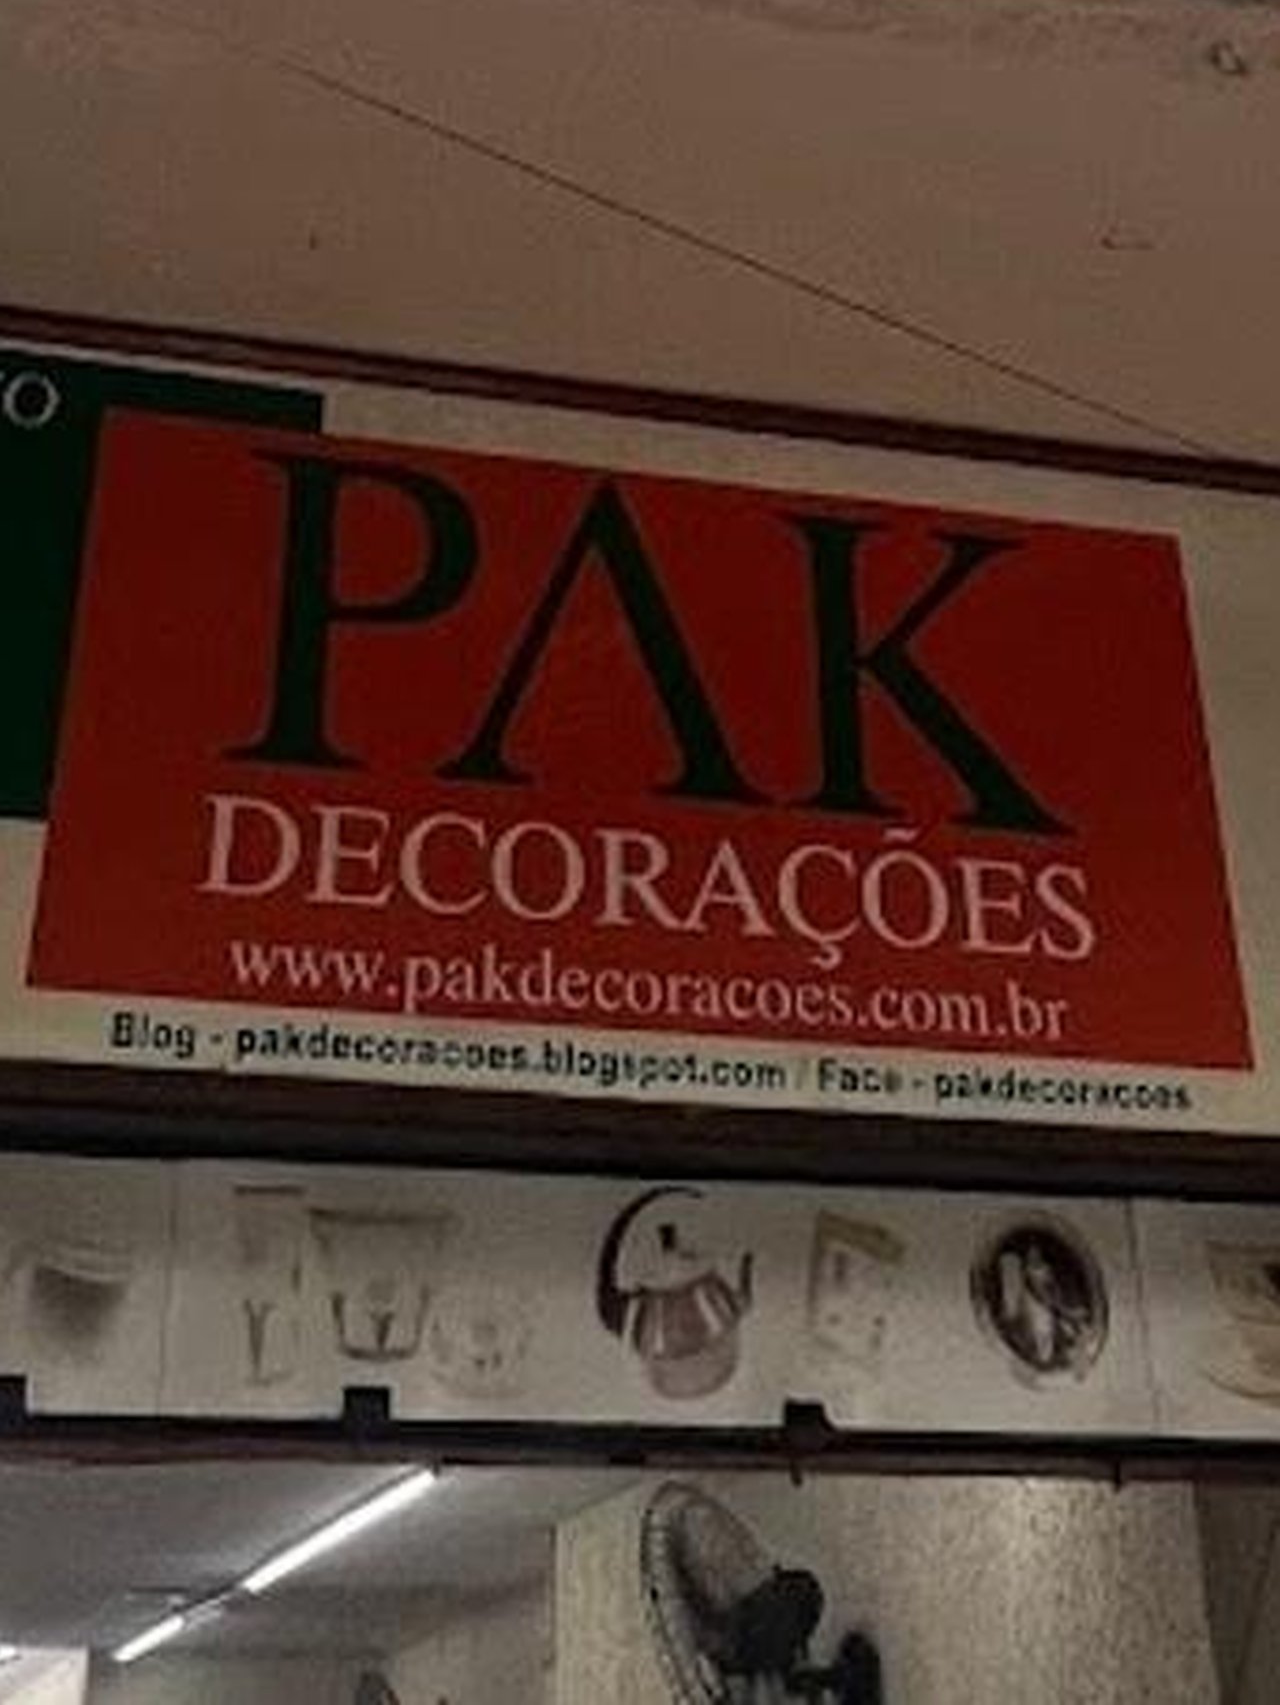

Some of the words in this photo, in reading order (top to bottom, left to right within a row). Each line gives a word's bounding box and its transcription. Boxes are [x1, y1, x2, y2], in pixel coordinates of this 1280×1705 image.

[219, 449, 1077, 837] PAK
[196, 793, 1096, 967] DECORAÇÕES
[229, 940, 1070, 1042] www.pakdecoracoes.com.br
[110, 1012, 196, 1057] Blog
[235, 1024, 787, 1089] pakdecoracoes.blogspot.com
[819, 1058, 902, 1094] Face
[934, 1067, 1193, 1111] pakdecoracoes
